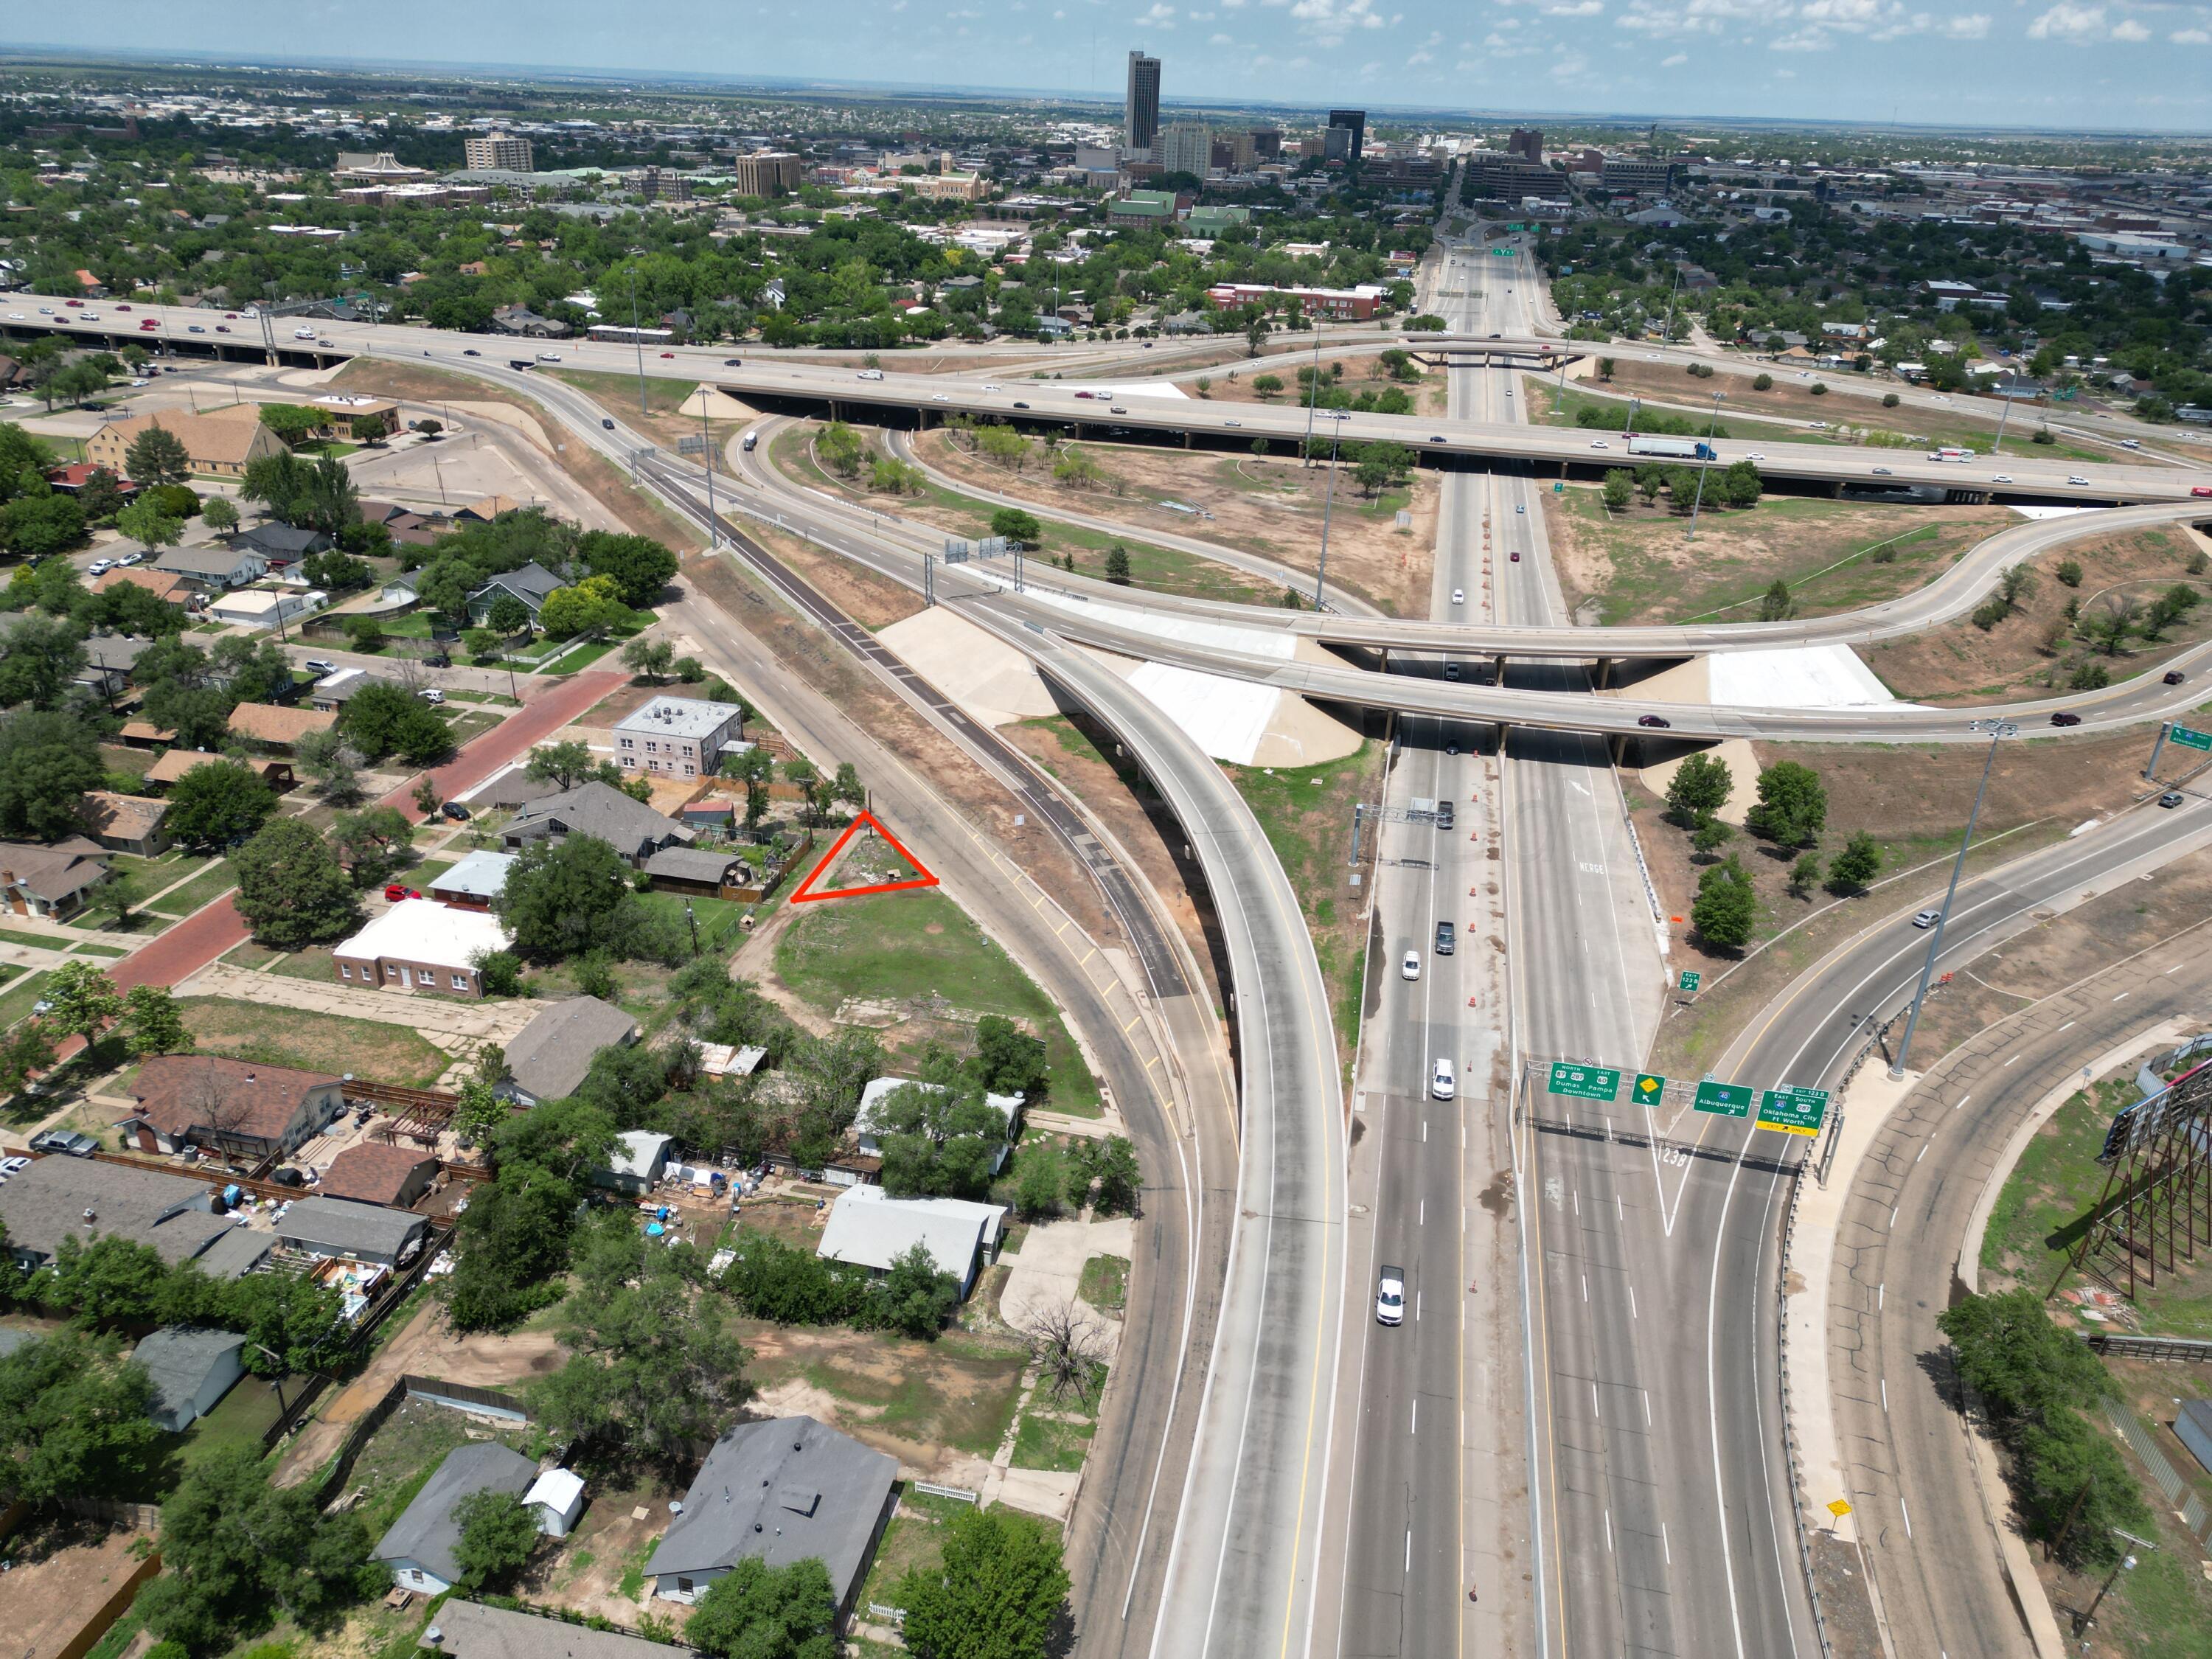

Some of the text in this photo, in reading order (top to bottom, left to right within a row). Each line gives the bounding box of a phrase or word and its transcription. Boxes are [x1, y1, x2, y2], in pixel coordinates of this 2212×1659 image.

[2173, 737, 2207, 748] Albuquerque
[1579, 862, 1604, 874] MERGE
[1556, 1080, 1613, 1093] Dumas Pampa
[1562, 1088, 1601, 1098] Downtown
[1699, 1099, 1745, 1110] Albuquerque
[1763, 1109, 1799, 1119] Oklahoma
[1658, 1145, 1687, 1167] 123B
